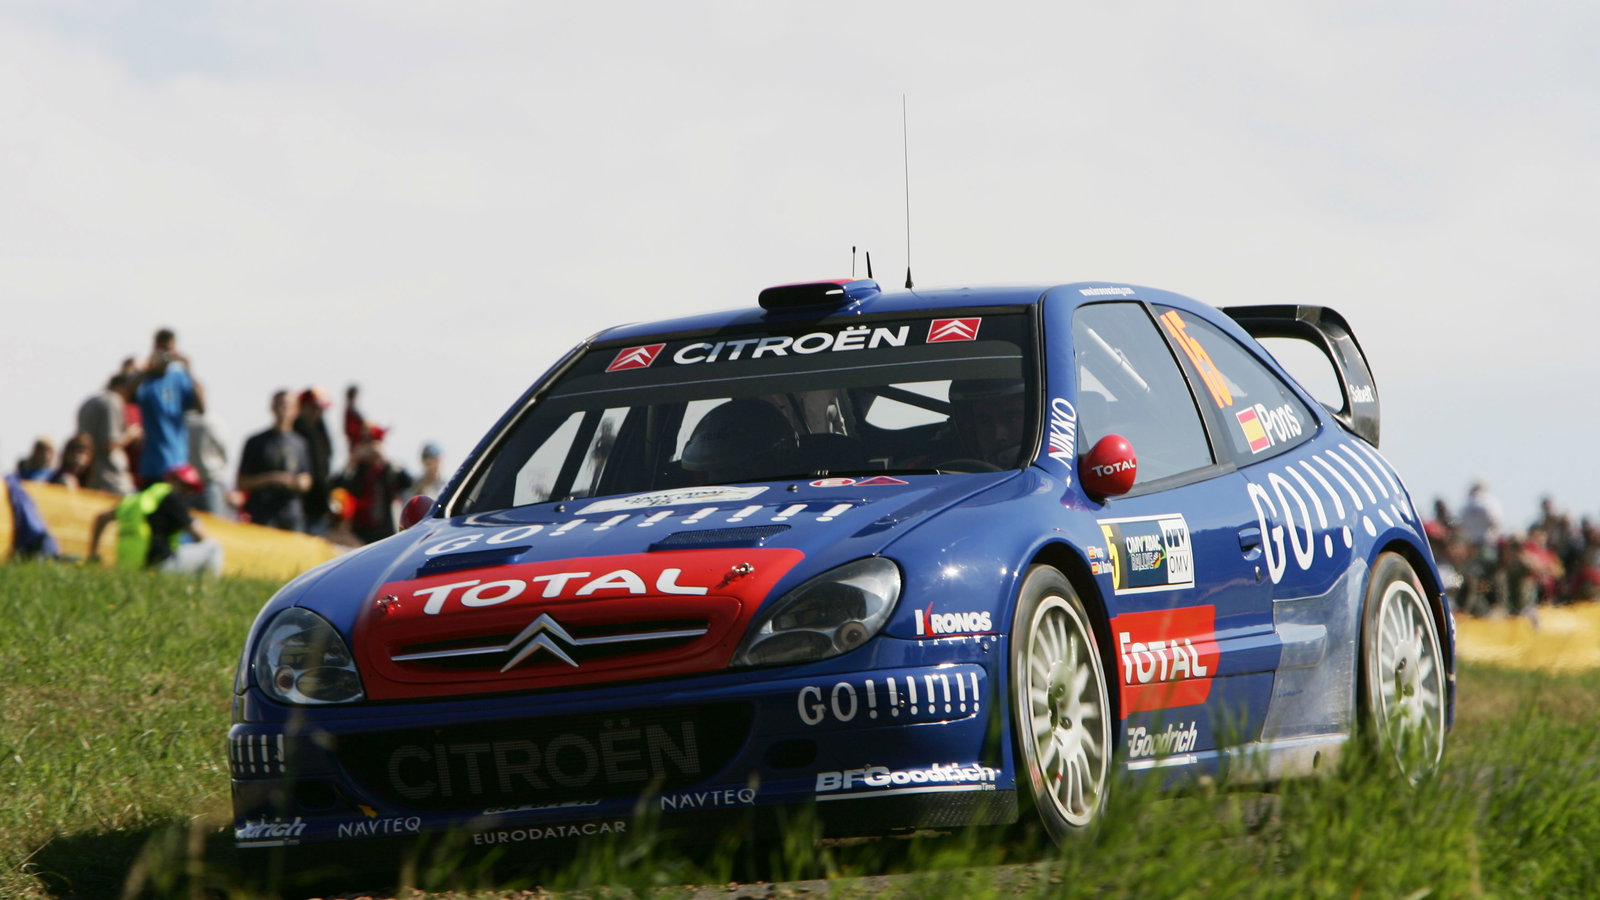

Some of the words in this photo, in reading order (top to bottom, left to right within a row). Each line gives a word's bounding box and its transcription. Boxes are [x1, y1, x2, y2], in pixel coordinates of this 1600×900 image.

[673, 325, 910, 365] CITROËN
[1048, 397, 1077, 471] NIKKO
[1254, 403, 1302, 446] Pons
[1091, 458, 1136, 477] TOTAL
[1169, 555, 1189, 573] OMV
[413, 568, 709, 615] TOTAL
[914, 601, 993, 637] KRONOS
[1119, 631, 1208, 684] TOTAL
[388, 717, 702, 800] CITROËN
[815, 763, 996, 792] BFGoodrich
[661, 788, 756, 811] NAVTEQ
[338, 816, 422, 838] NAVTEQ
[473, 821, 627, 845] EURODATACAR
